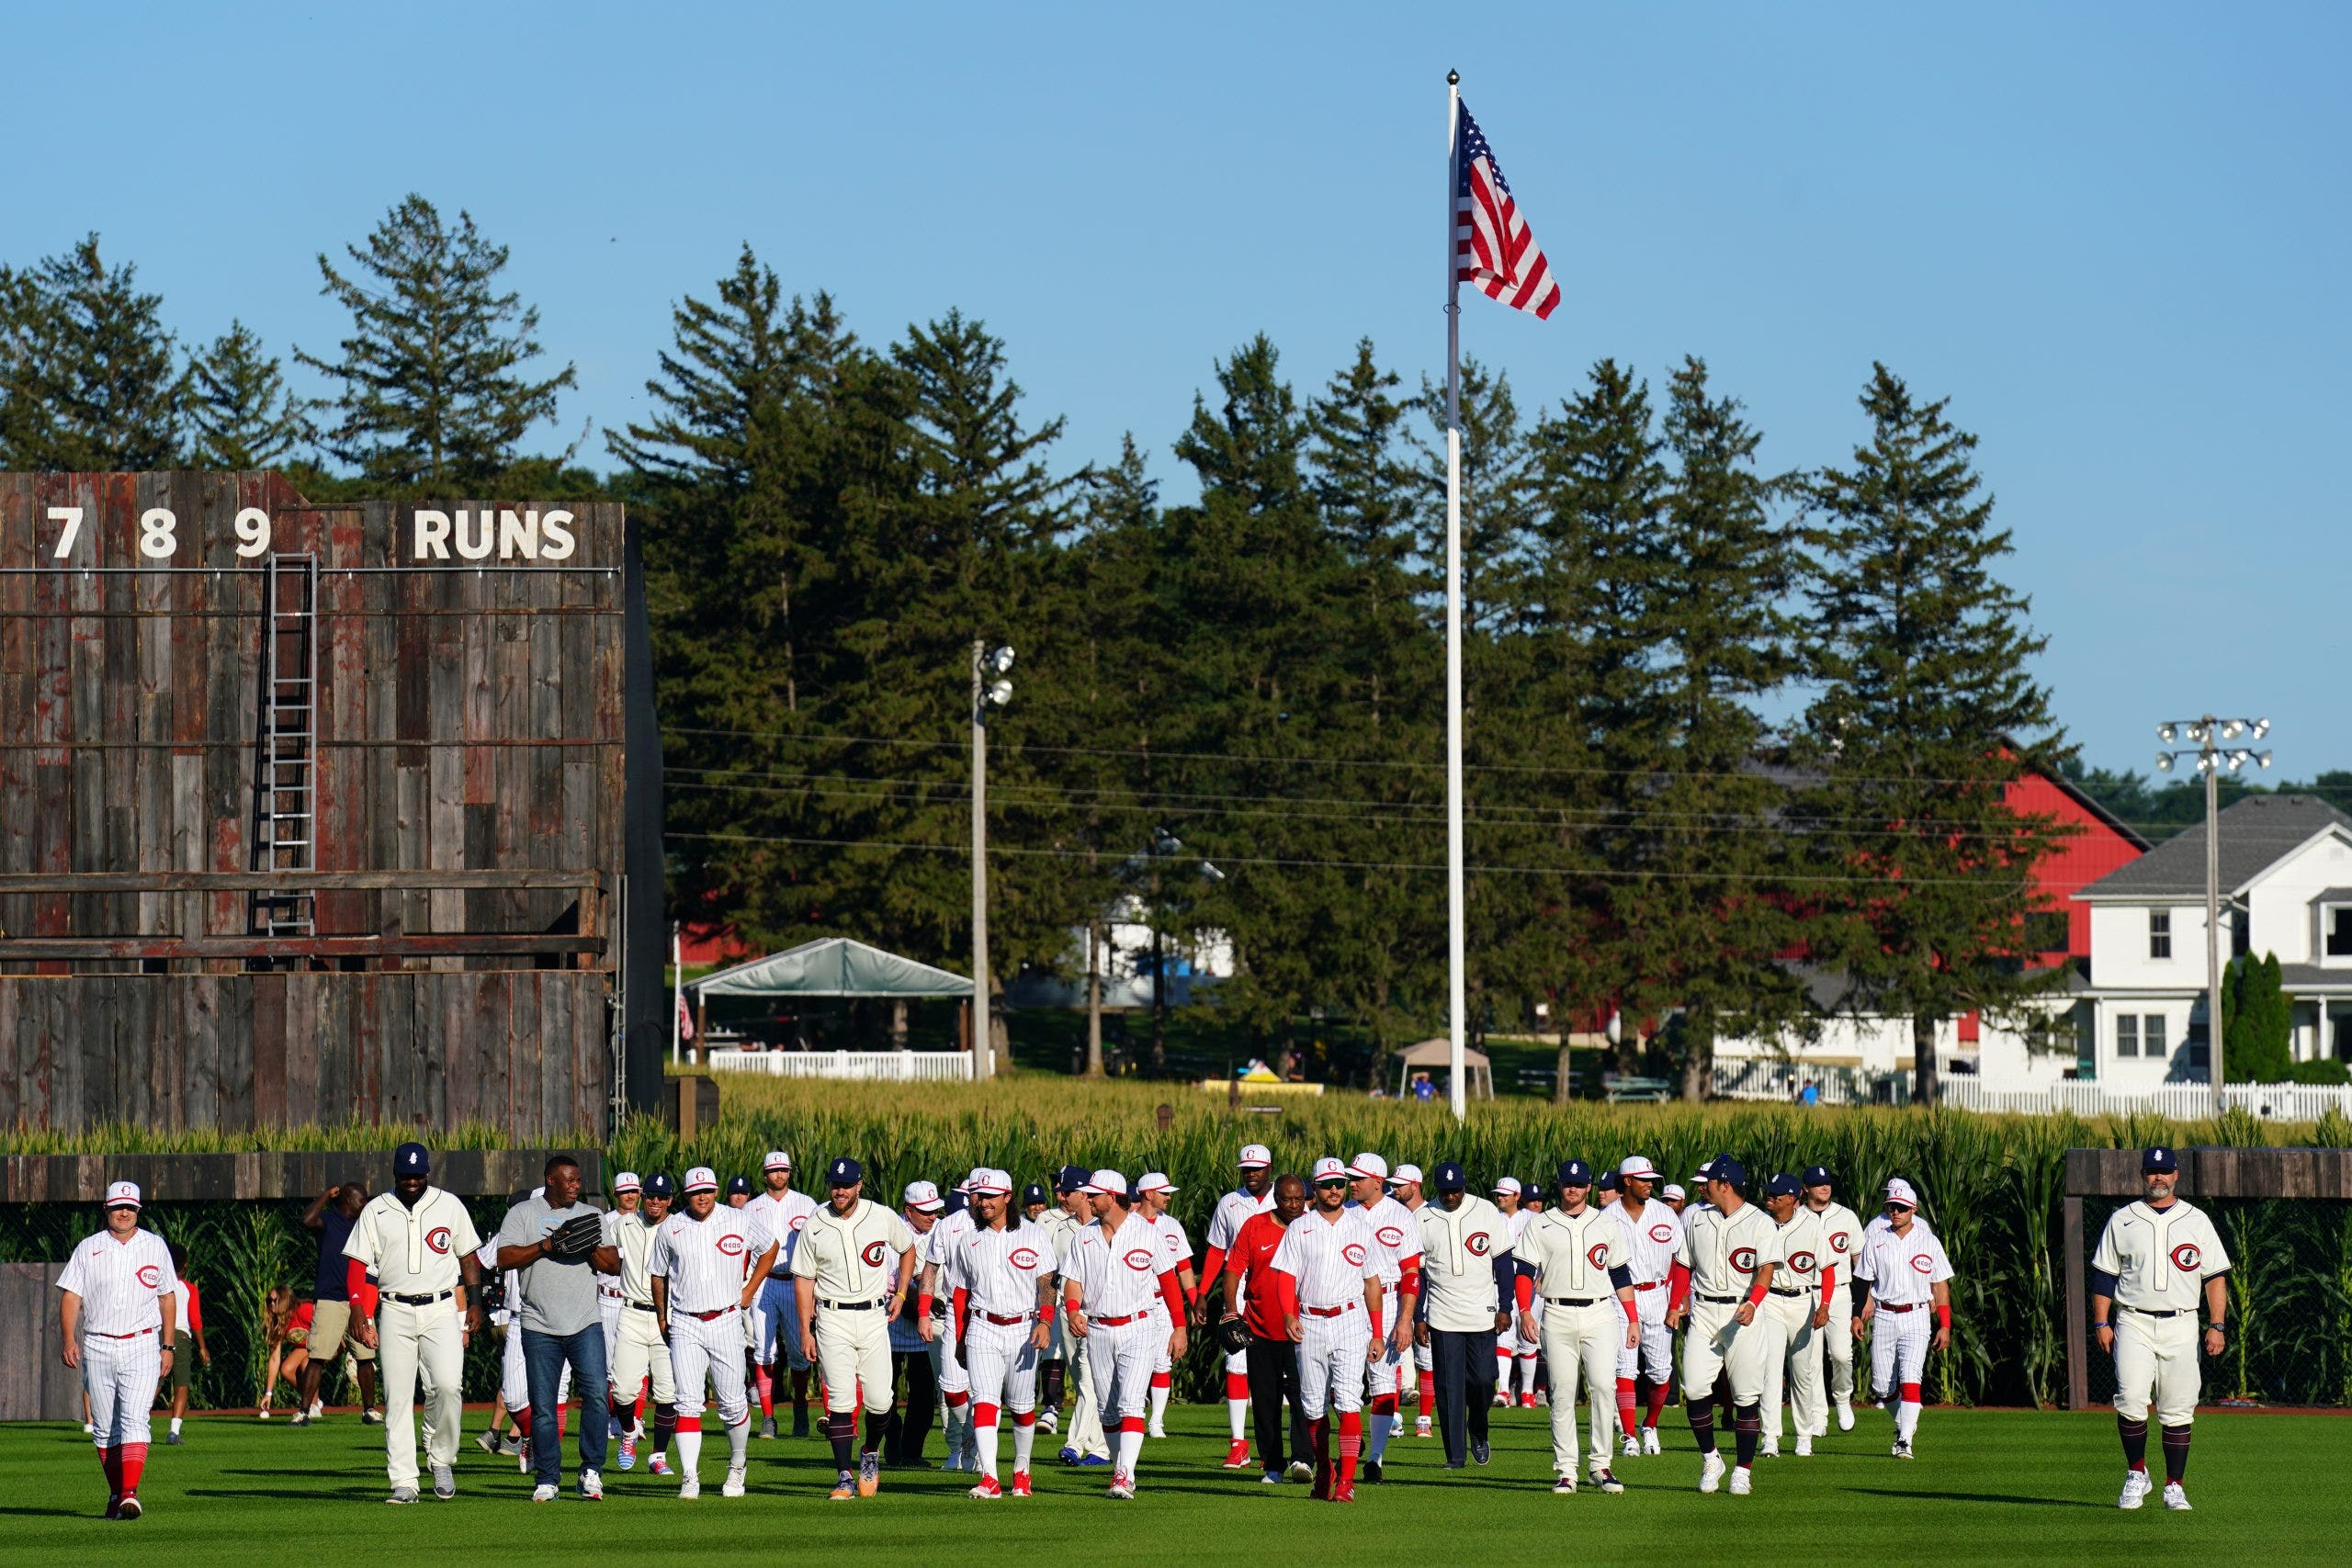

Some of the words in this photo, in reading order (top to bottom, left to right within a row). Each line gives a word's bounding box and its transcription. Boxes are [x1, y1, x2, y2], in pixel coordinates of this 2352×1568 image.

[47, 506, 84, 558] 7
[140, 507, 177, 558] 8
[234, 507, 271, 558] 9
[414, 510, 575, 559] RUNS
[1246, 1149, 1255, 1159] C
[1328, 1160, 1337, 1171] C
[695, 1171, 705, 1182] C
[981, 1175, 990, 1186] C
[121, 1185, 131, 1196] C
[1382, 1233, 1401, 1241] REDS
[1015, 1255, 1035, 1263] REDS
[1130, 1256, 1149, 1264] REDS
[1349, 1250, 1364, 1260] REDS
